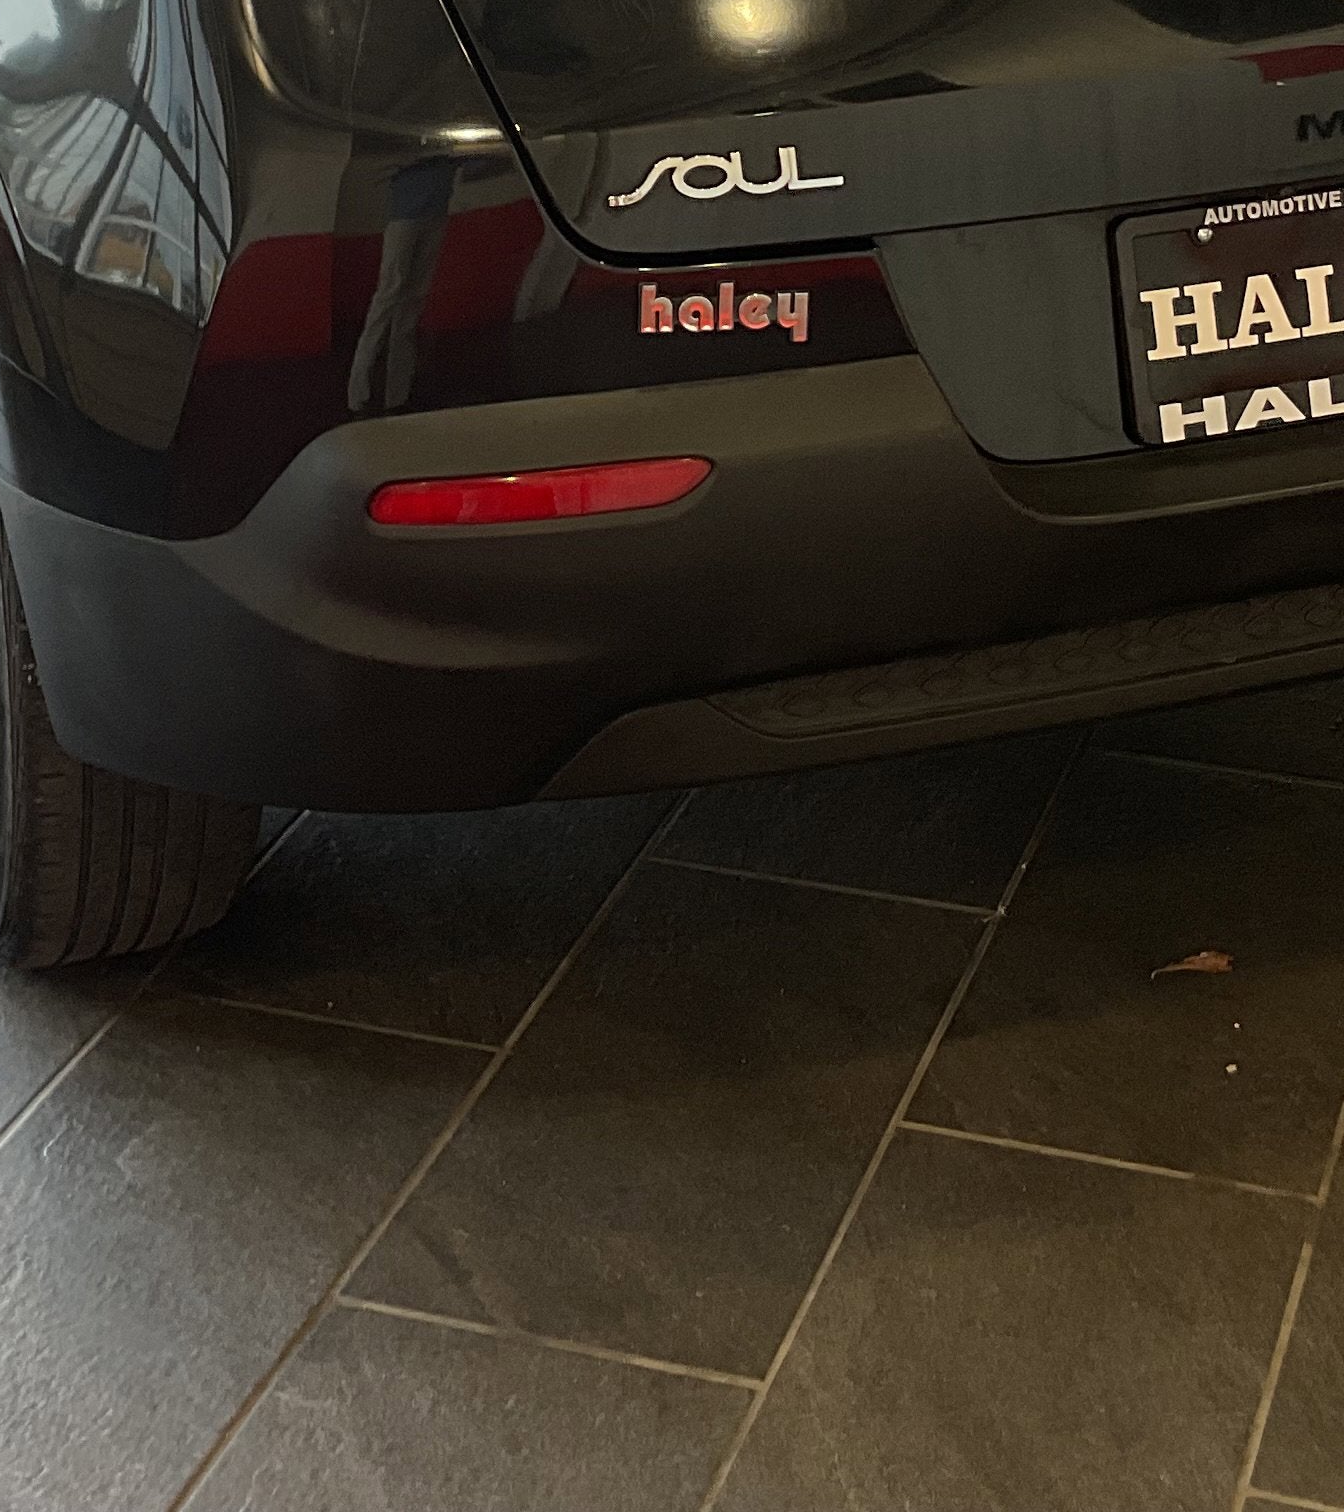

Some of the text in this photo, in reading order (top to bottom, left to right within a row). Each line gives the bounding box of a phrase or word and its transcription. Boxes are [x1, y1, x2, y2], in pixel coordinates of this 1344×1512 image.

[608, 146, 845, 207] SOUL
[1203, 189, 1343, 226] AUTOMOTIVE
[639, 281, 810, 344] haley
